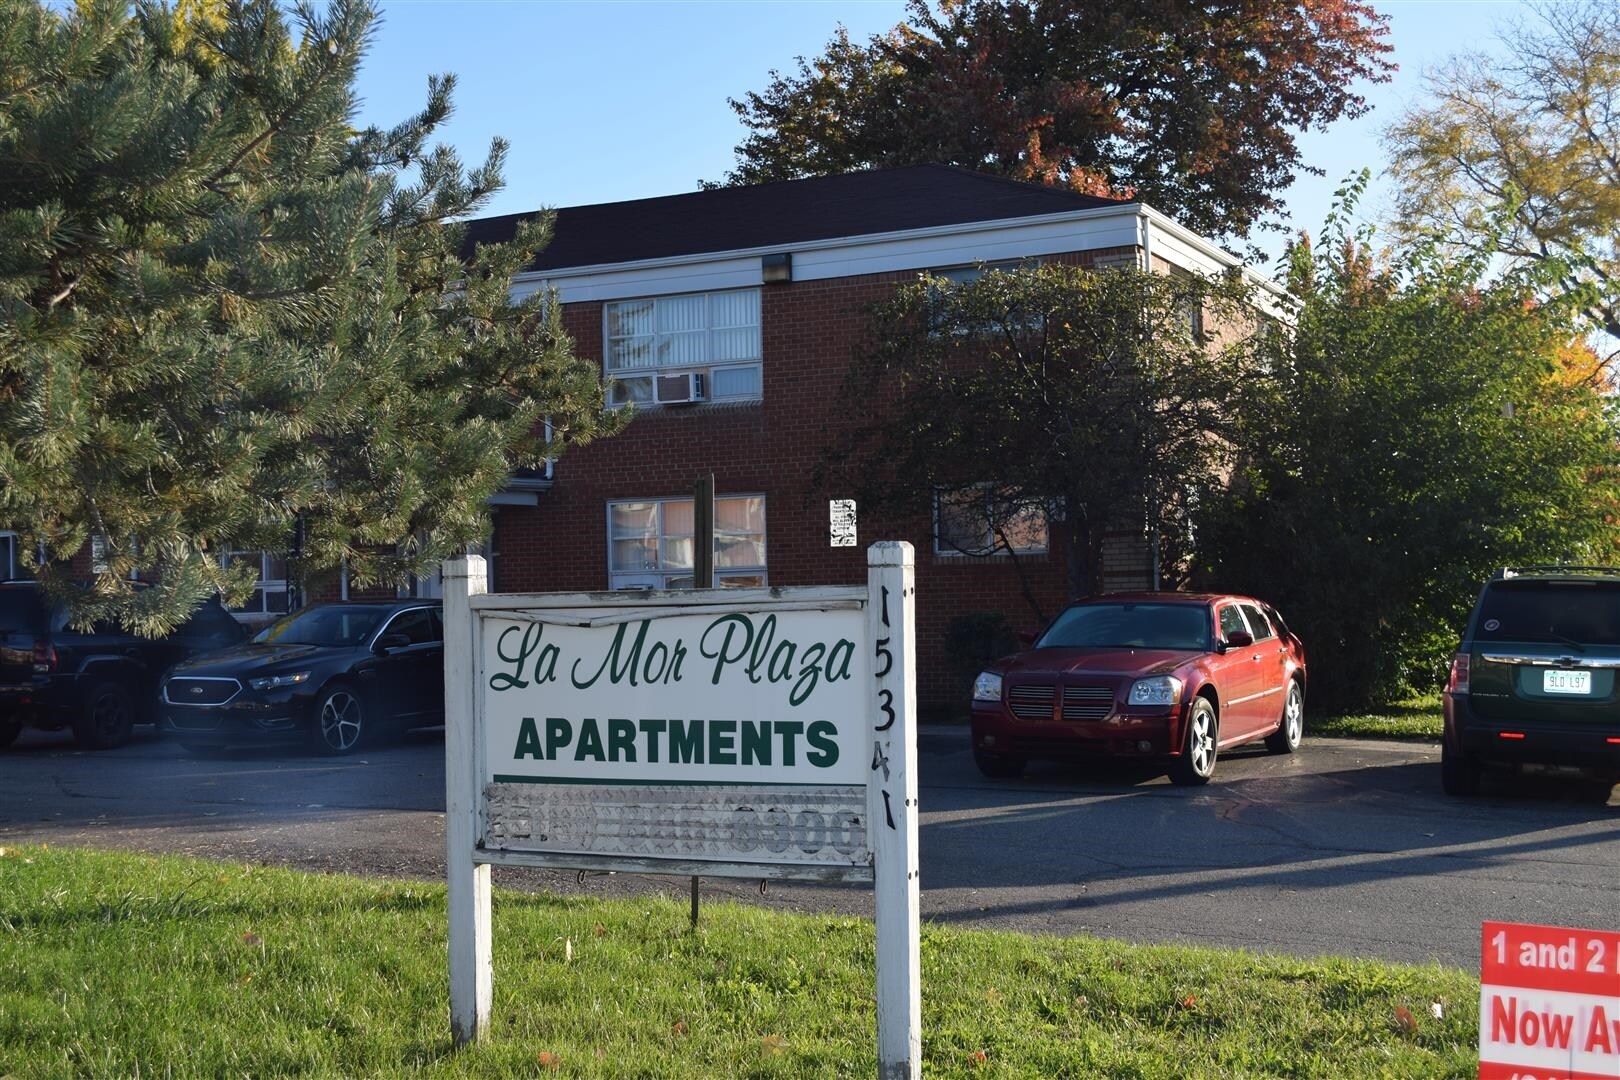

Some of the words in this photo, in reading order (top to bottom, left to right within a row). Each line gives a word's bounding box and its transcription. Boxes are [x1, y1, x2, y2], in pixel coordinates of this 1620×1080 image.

[489, 621, 561, 692] La
[571, 619, 689, 690] Mor
[700, 613, 856, 707] Plaza
[871, 585, 896, 830] 15341
[513, 717, 840, 768] APARTMENTS
[1492, 930, 1506, 964] 1
[1519, 937, 1576, 971] and
[1586, 938, 1606, 974] 2
[1491, 995, 1574, 1050] Now
